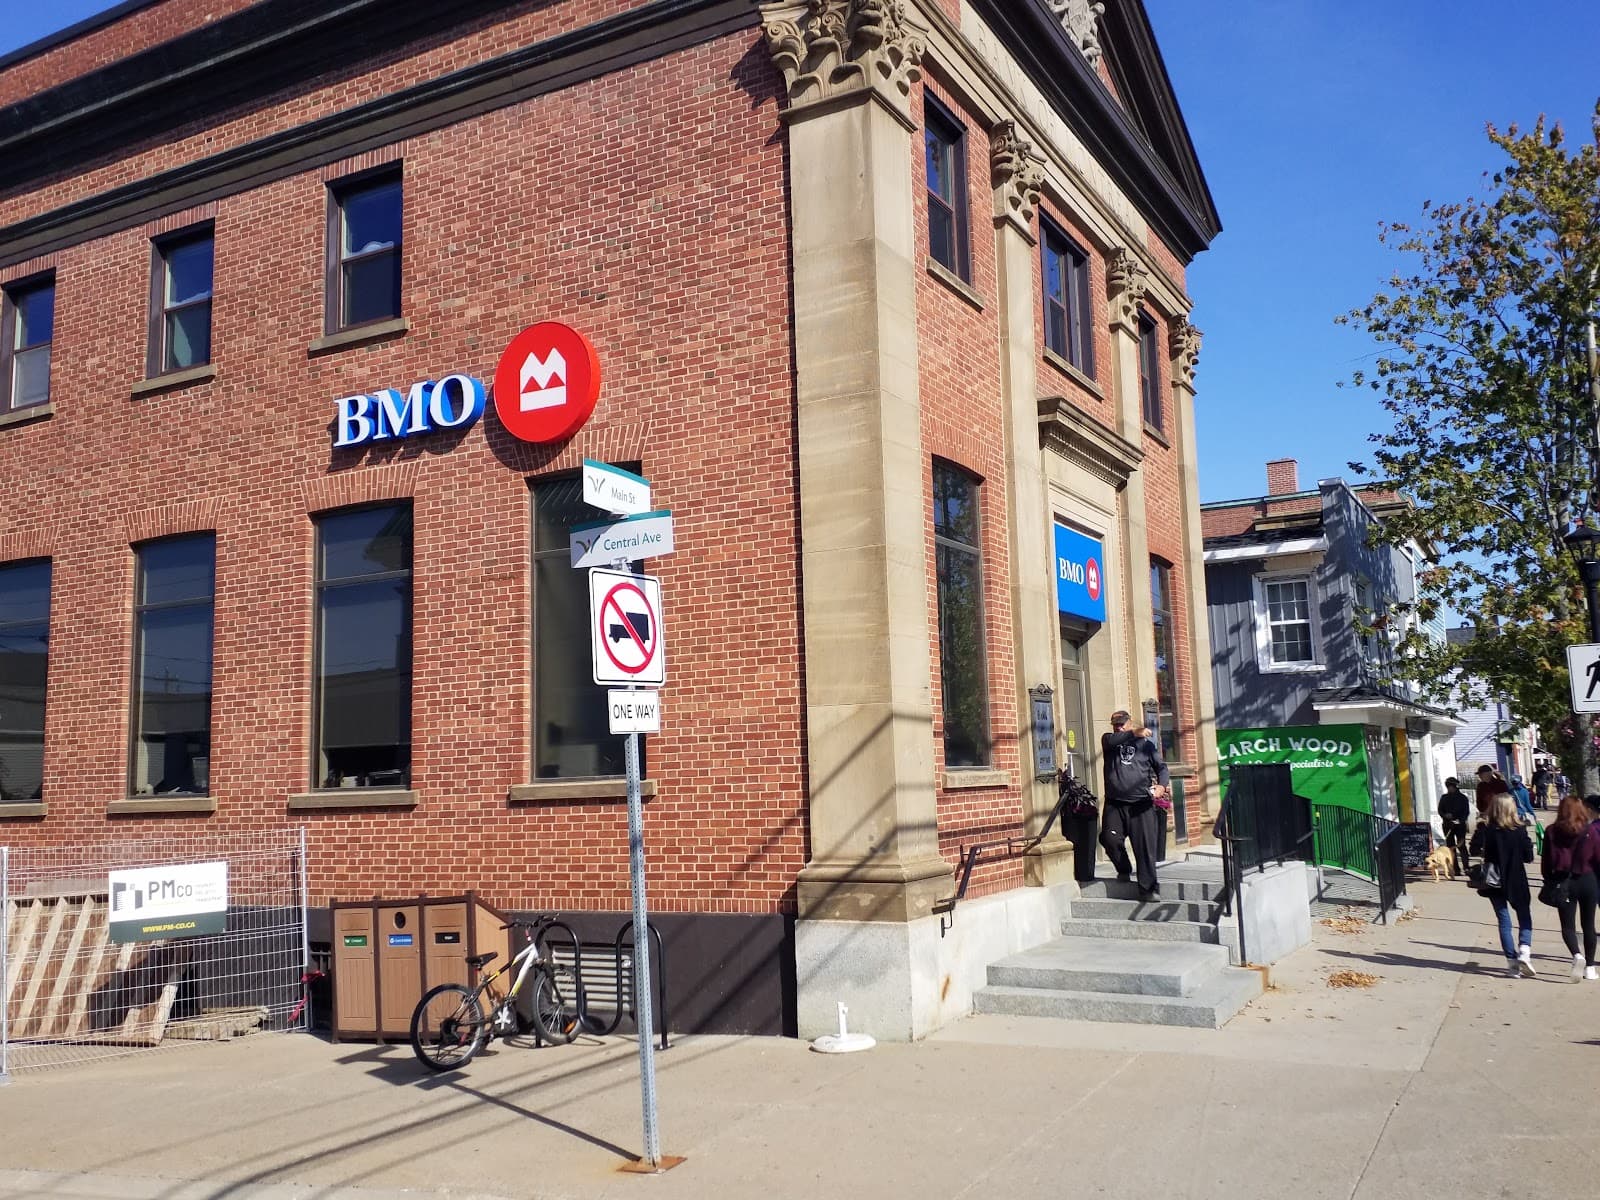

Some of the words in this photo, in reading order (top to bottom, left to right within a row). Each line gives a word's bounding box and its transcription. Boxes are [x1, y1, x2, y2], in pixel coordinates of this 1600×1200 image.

[333, 374, 479, 447] BMO
[611, 487, 628, 503] Main
[629, 491, 636, 505] St
[603, 533, 640, 551] Central
[642, 531, 662, 546] Ave
[1058, 557, 1085, 585] BMO
[613, 704, 633, 719] ONE
[635, 703, 655, 719] WAY
[1216, 737, 1281, 760] LARCH
[1288, 736, 1353, 757] WOOD
[148, 879, 193, 901] PMco
